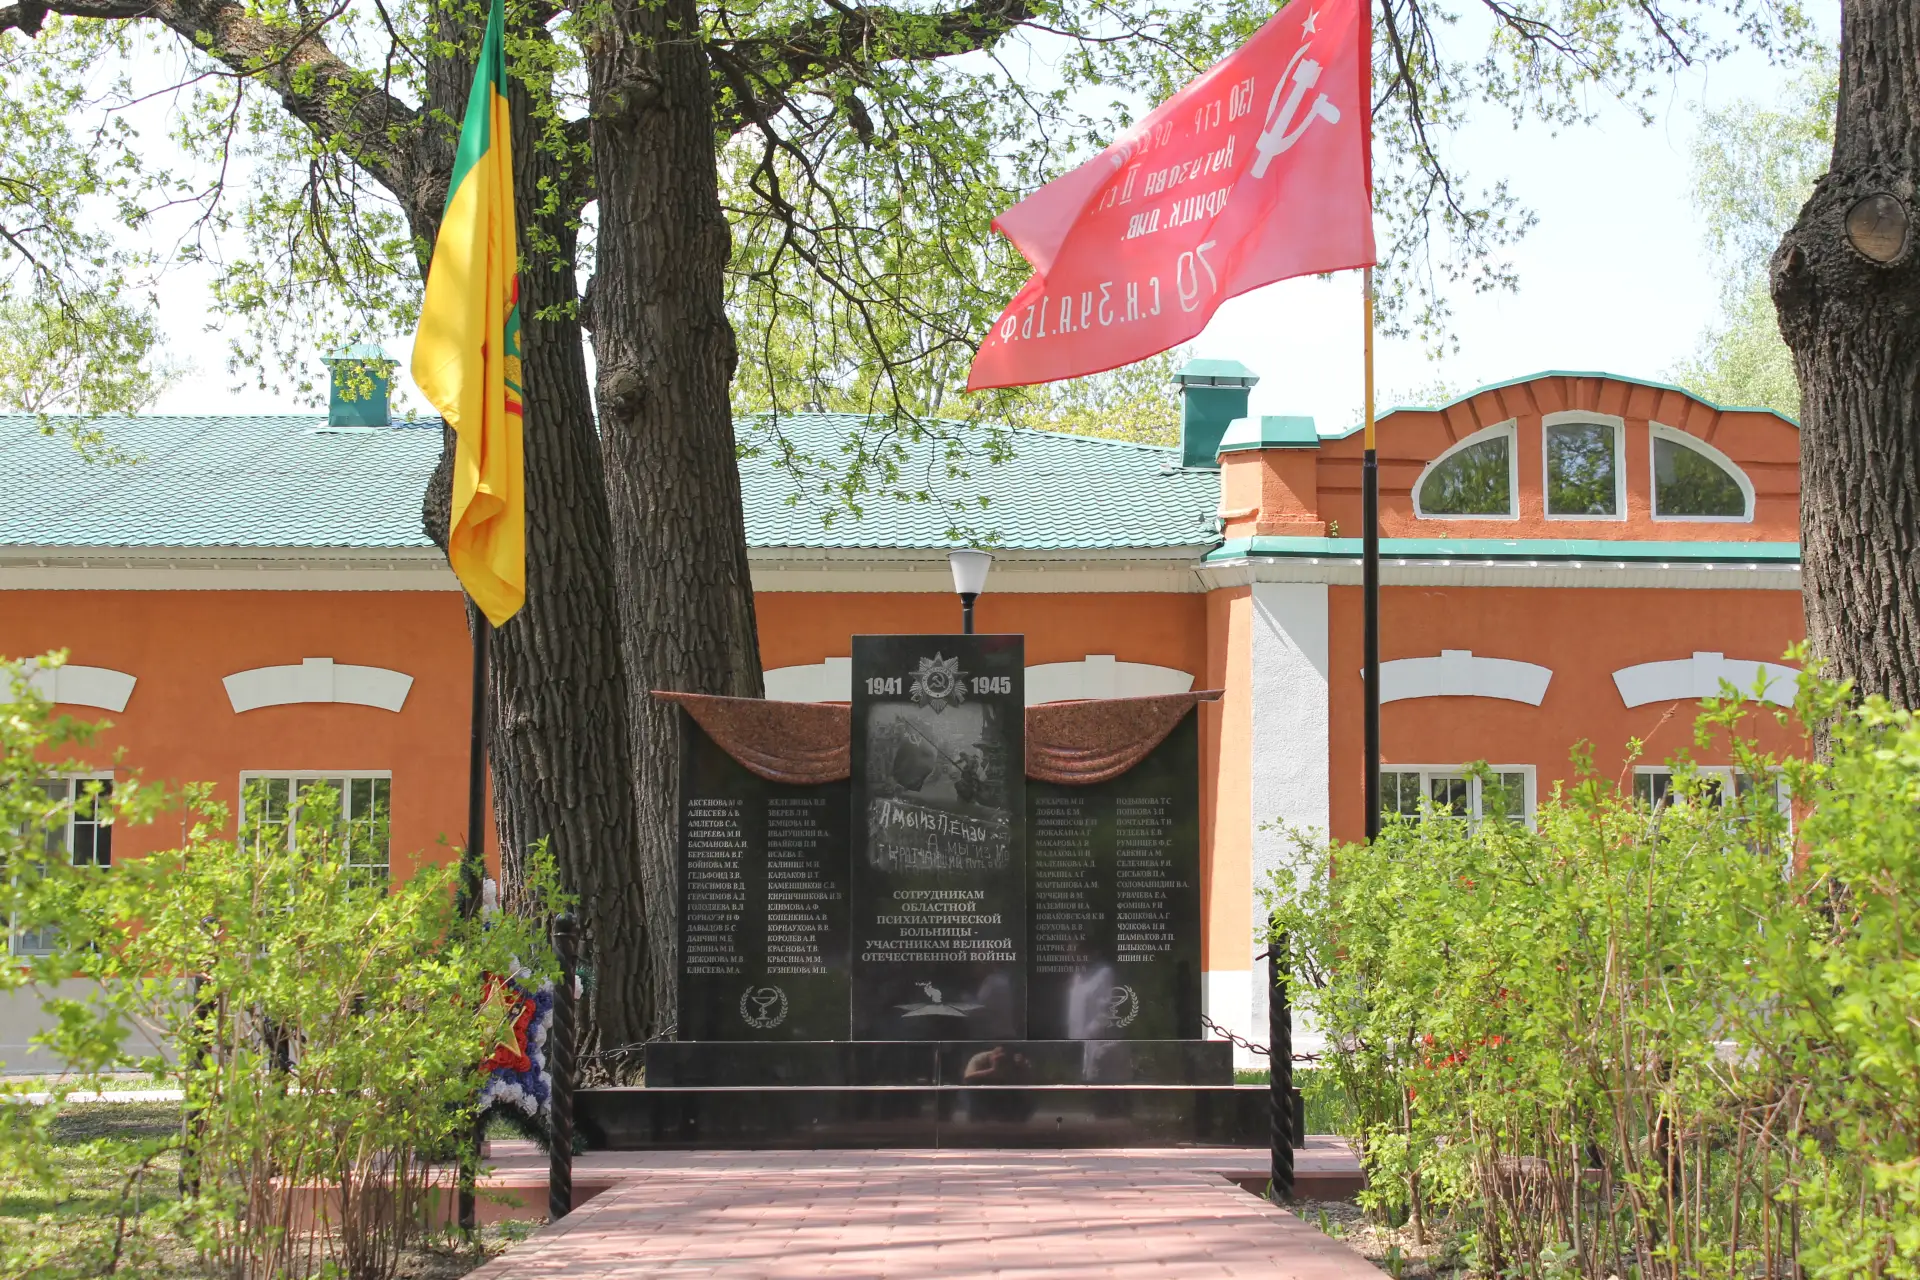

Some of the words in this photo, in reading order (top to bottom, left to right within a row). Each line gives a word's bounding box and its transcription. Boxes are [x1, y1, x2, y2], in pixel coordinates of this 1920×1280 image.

[865, 677, 902, 695] 1941
[971, 676, 1011, 694] 1945
[688, 882, 732, 890] ГЕРАСИМОВ
[893, 890, 984, 900] СОТРУДНИКАМ
[901, 902, 976, 912] ОБЛАСТНОЙ
[877, 913, 1002, 925] ПСИХИАТРИЧЕСКОЙ
[900, 928, 972, 937] БОЛЬНИЦЫ
[768, 945, 806, 953] КРАСНОВА
[866, 940, 950, 950] УЧАСТНИКАМ
[953, 938, 1012, 949] ВЕЛИКОЙ
[862, 951, 967, 962] ОТЕЧЕСТВЕННОЙ
[970, 951, 1016, 961] ВОЙНЫ
